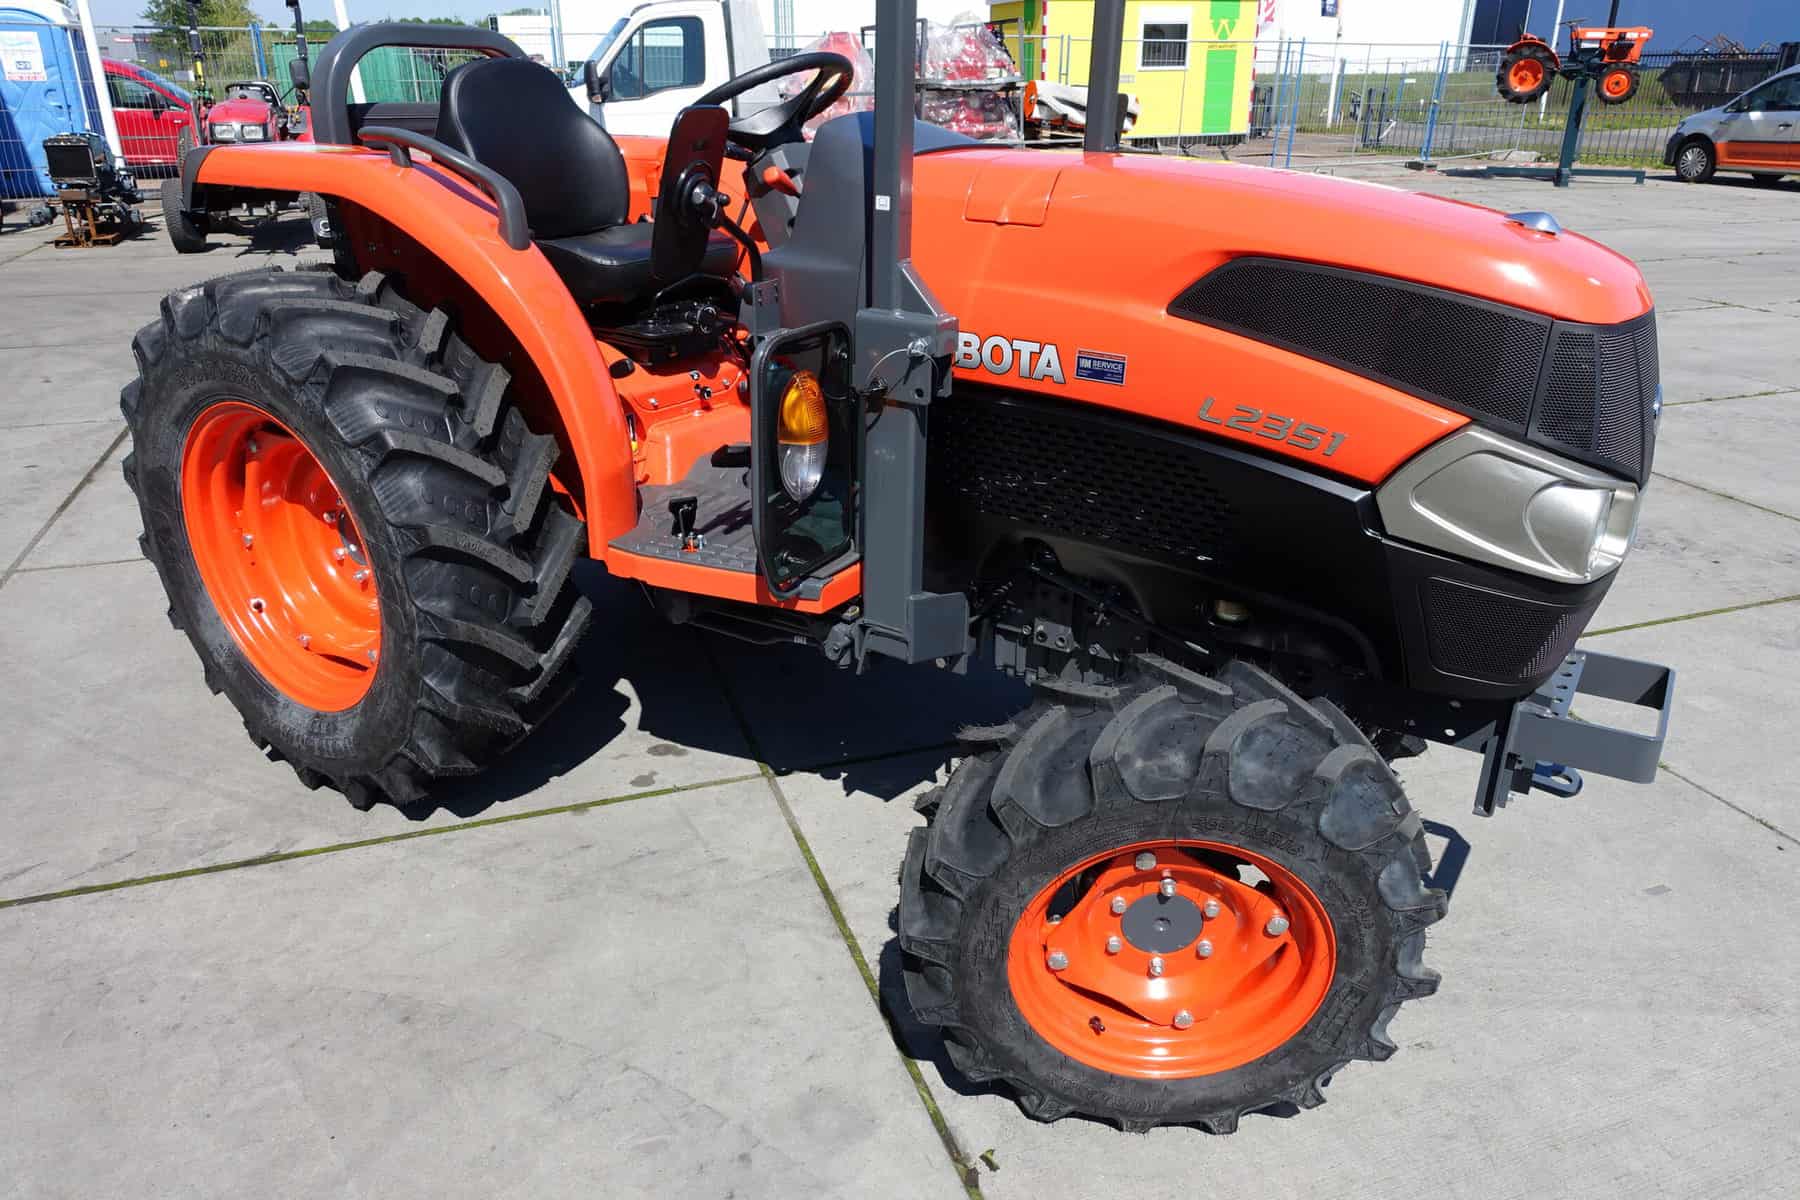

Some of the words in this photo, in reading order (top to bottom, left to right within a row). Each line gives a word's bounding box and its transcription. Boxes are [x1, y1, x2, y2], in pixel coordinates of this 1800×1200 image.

[954, 330, 1066, 384] BOTA
[1092, 359, 1123, 371] SERVICE
[1198, 396, 1349, 457] L2351
